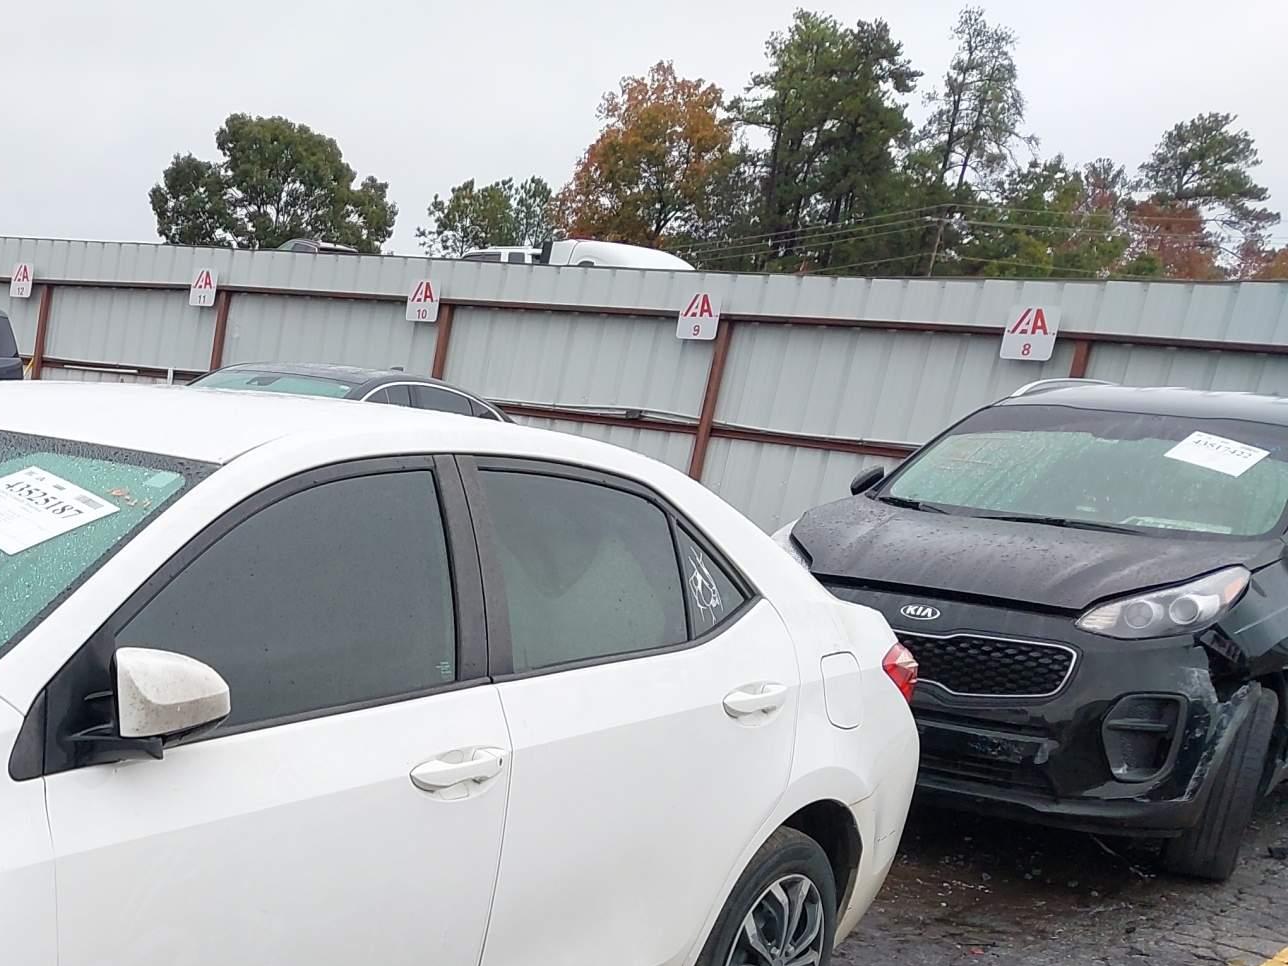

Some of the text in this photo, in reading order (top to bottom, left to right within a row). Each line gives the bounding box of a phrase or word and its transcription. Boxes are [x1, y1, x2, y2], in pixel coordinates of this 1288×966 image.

[17, 287, 25, 296] 12
[198, 295, 206, 304] 11
[416, 309, 428, 320] 10
[692, 324, 701, 336] 9
[1021, 343, 1032, 356] 8
[5, 481, 84, 519] 43525187
[905, 605, 933, 618] KIA
